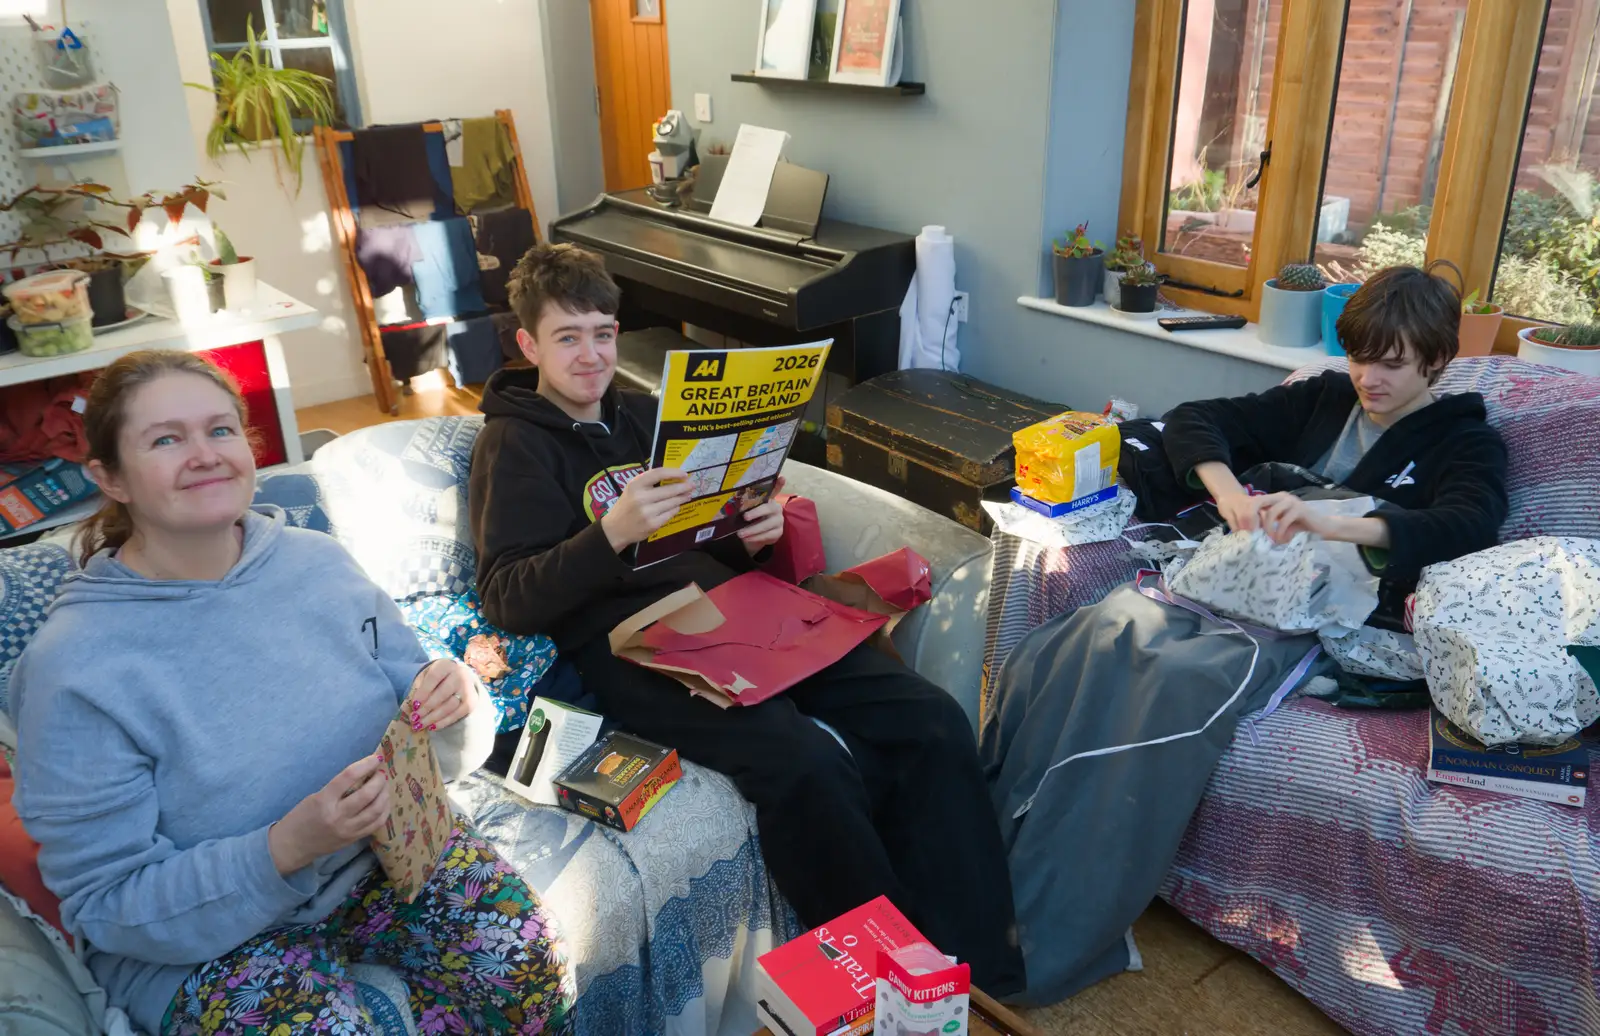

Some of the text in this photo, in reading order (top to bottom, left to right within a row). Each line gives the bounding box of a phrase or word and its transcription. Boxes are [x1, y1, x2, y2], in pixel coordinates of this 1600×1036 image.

[692, 359, 719, 377] AA
[772, 353, 820, 373] 2026
[680, 376, 813, 401] GREAT BRITAIN
[686, 391, 801, 416] AND IRELAND
[682, 424, 697, 433] The
[698, 423, 714, 432] UK's
[715, 417, 754, 431] best-selling
[754, 414, 769, 424] road
[1071, 493, 1100, 510] HARRY'S
[1445, 757, 1497, 770] NORMAN
[1499, 763, 1557, 778] CONQUEST
[1435, 770, 1486, 787] Empireland
[888, 969, 955, 1002] CANDY KITTENS
